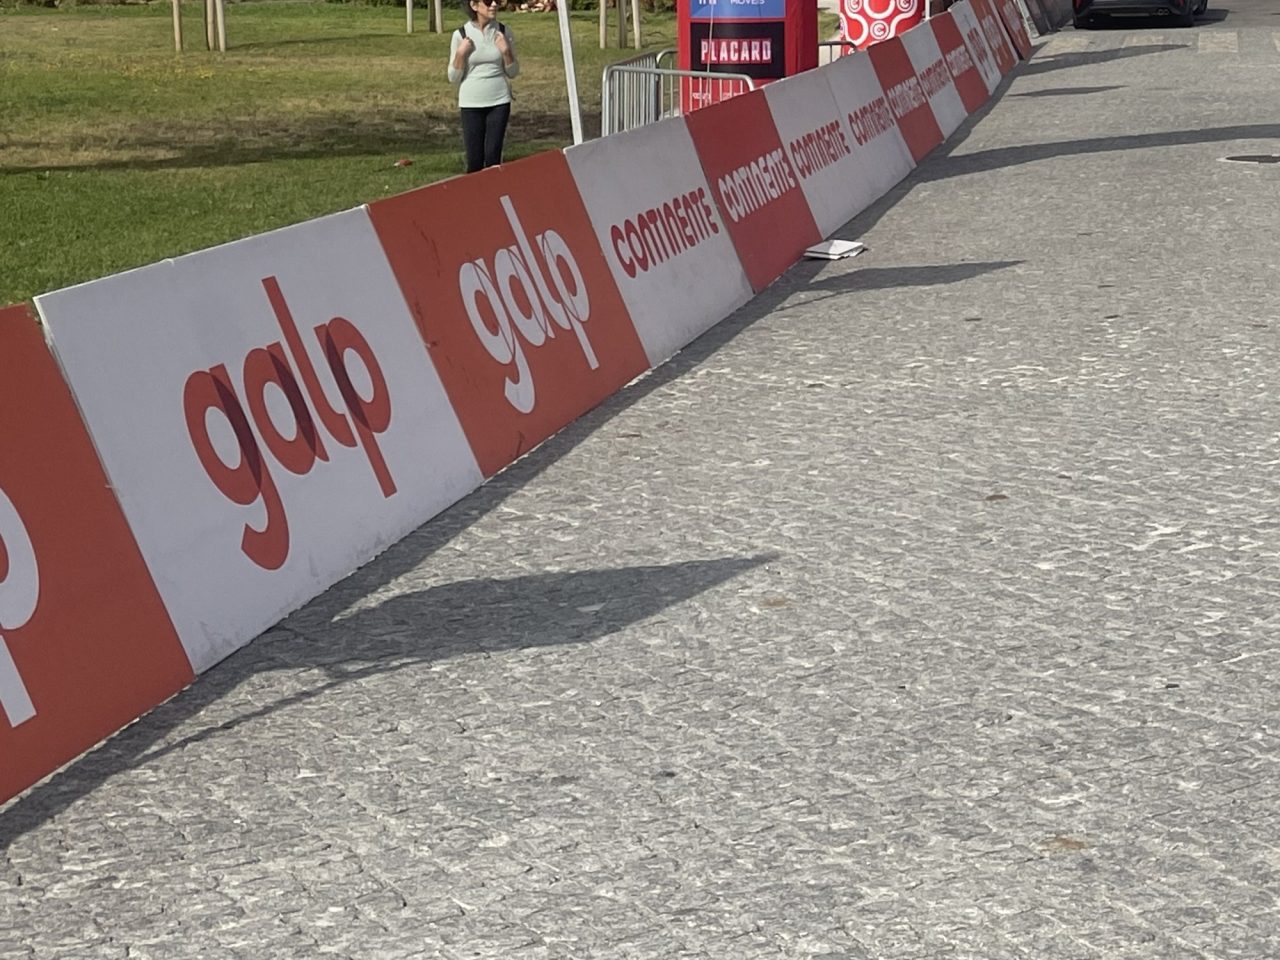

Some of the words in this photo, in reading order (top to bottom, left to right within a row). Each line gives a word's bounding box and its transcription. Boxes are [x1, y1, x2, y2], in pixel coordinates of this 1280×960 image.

[700, 40, 771, 63] PLACARD
[459, 195, 600, 414] galp
[183, 276, 397, 570] galp
